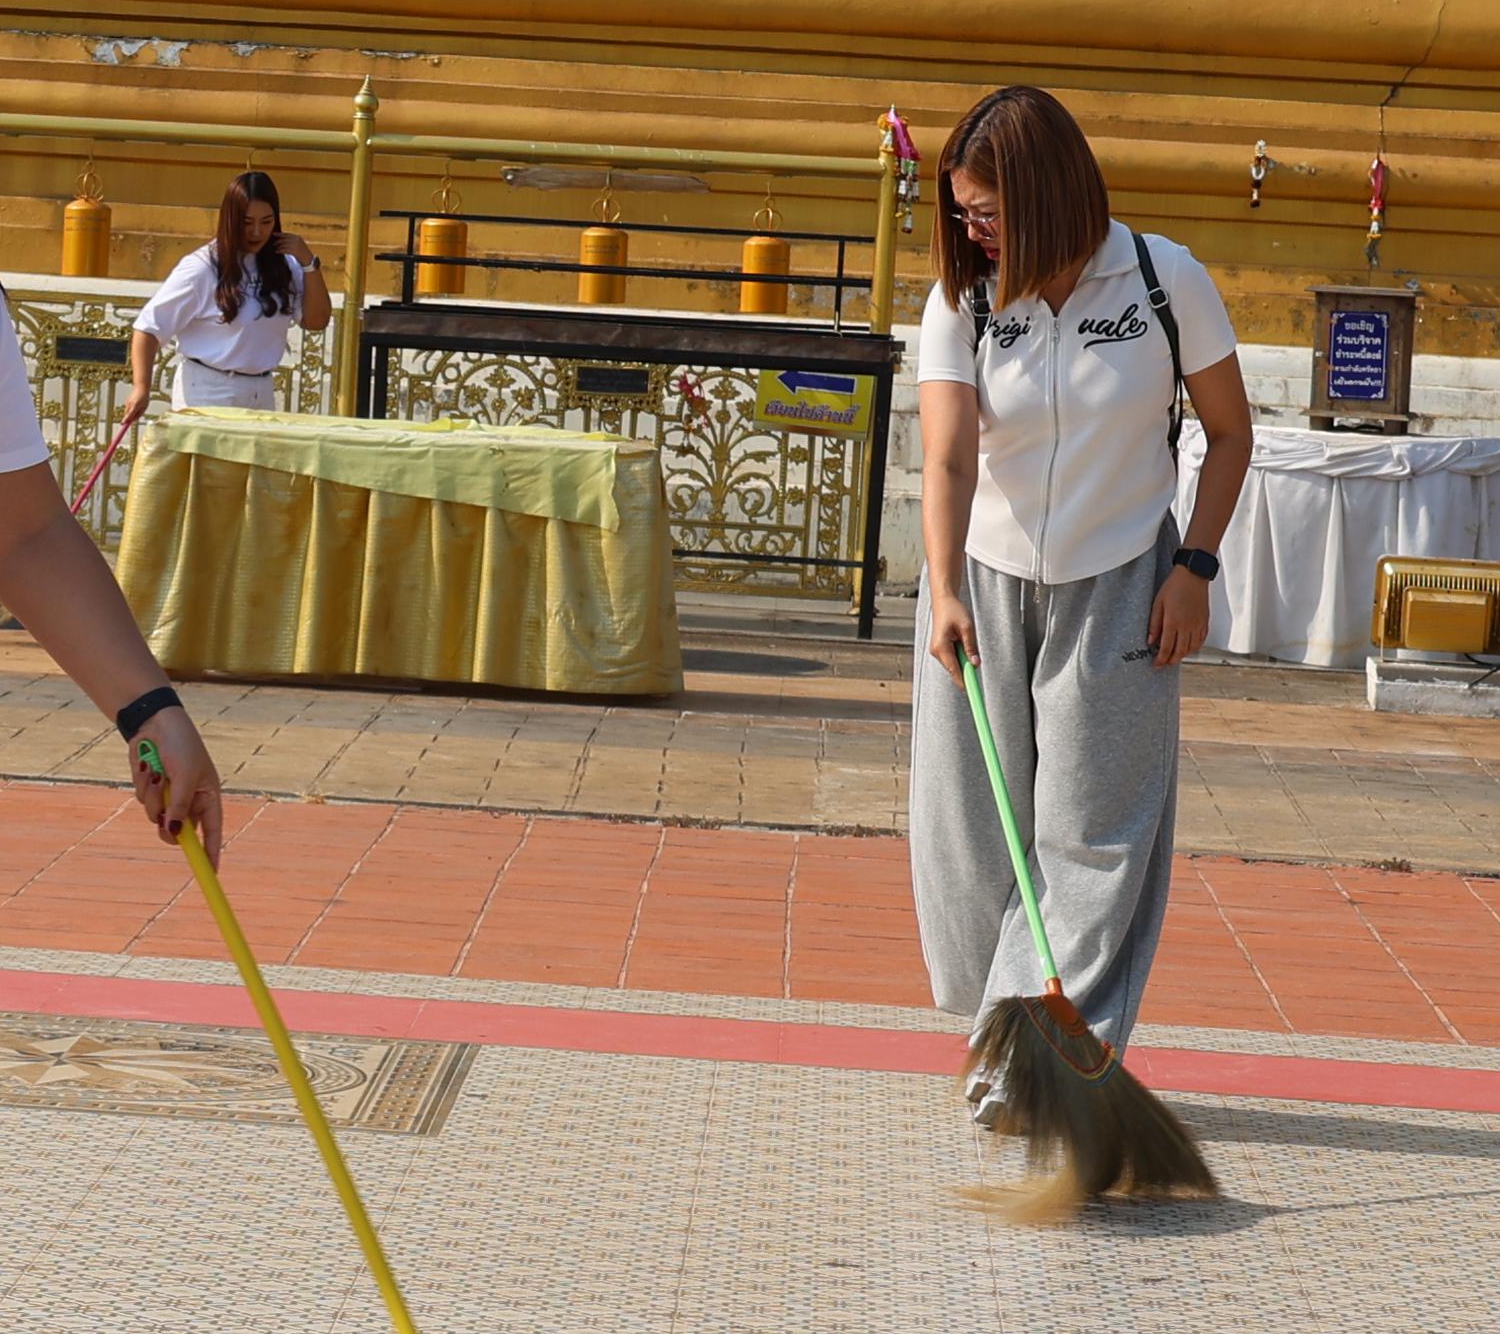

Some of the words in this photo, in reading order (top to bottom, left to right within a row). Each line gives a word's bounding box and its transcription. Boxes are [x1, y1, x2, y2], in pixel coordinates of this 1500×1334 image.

[1344, 319, 1375, 333] ขอเชิญ
[1336, 334, 1382, 345] ร่วมบริจาค
[764, 400, 862, 425] เวียนไปด้านนี้
